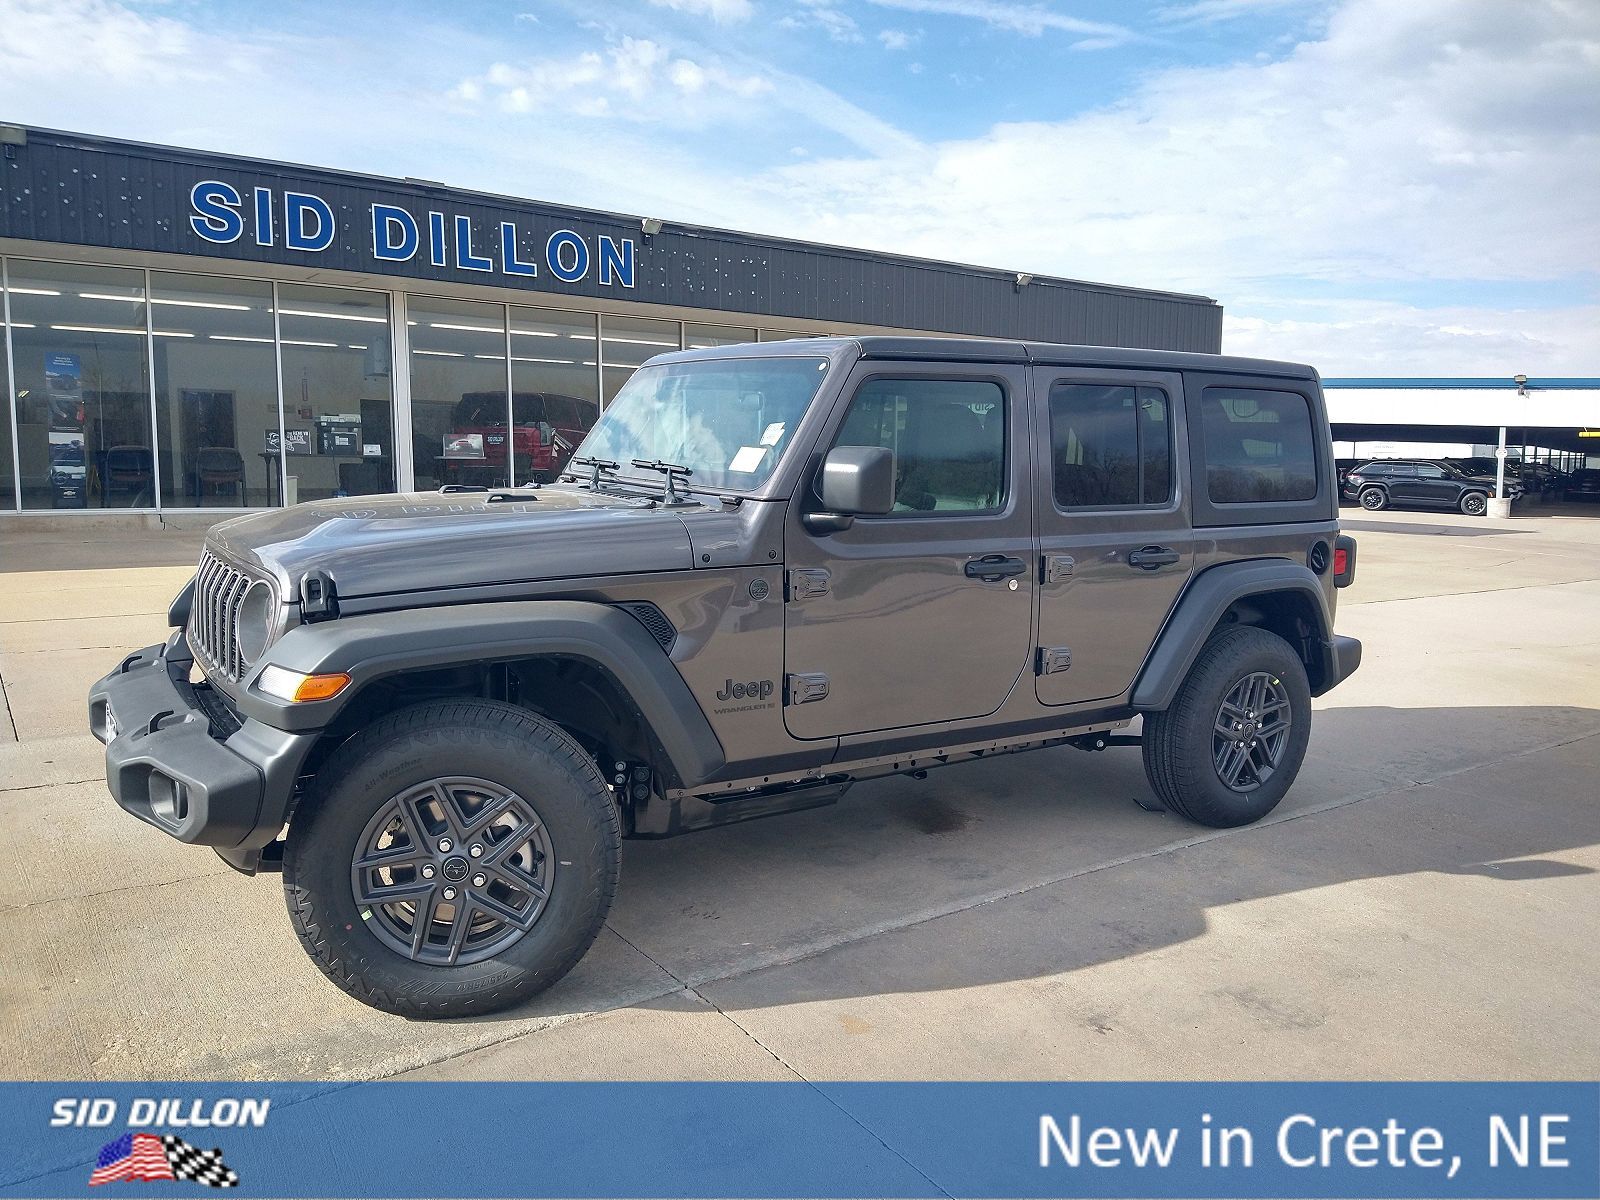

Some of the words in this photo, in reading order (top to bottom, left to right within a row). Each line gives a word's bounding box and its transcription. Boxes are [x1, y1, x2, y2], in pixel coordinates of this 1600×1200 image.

[189, 180, 336, 252] SID
[371, 202, 635, 288] DILLON
[716, 679, 774, 701] Jeep
[713, 704, 766, 714] WRANGLER
